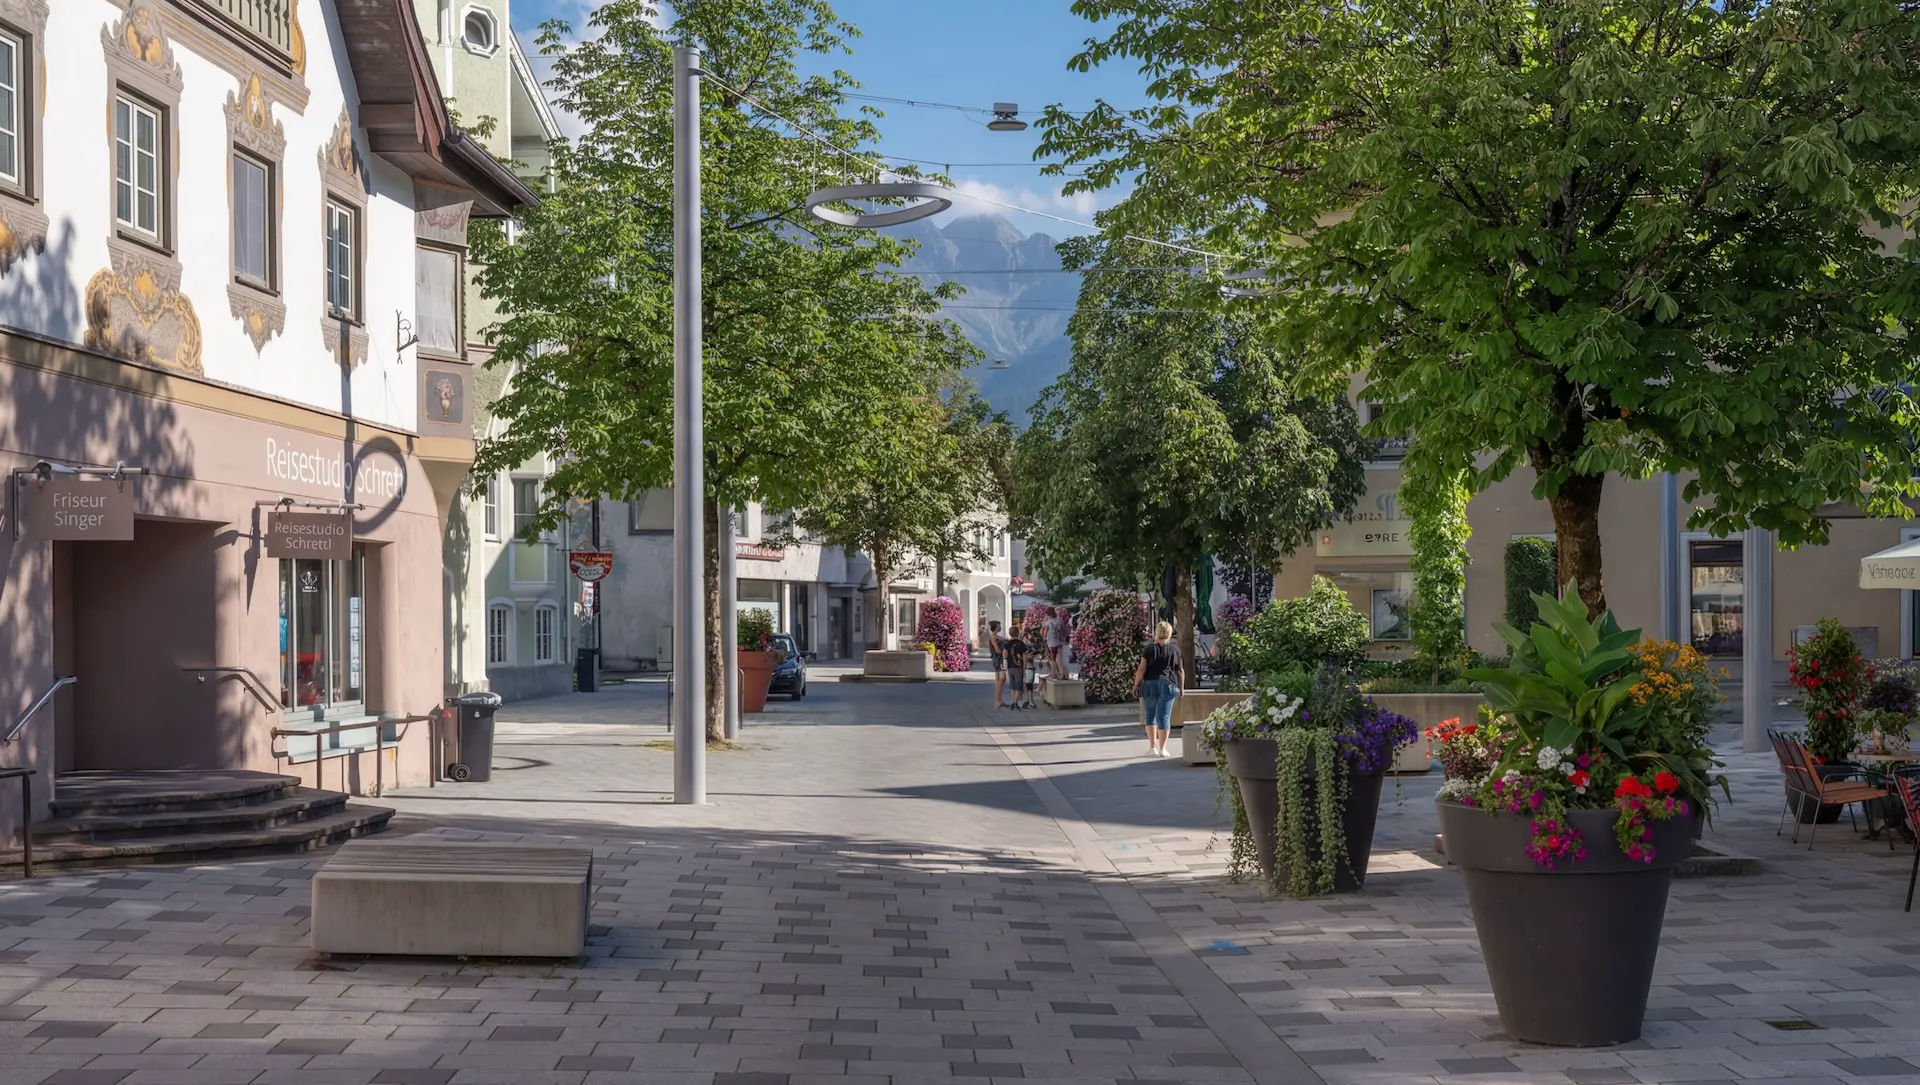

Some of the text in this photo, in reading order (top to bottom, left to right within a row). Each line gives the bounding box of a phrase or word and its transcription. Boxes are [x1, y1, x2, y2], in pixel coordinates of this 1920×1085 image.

[266, 437, 353, 491] Reisestudio
[53, 492, 107, 508] Friseur
[54, 511, 105, 531] Singer
[275, 521, 345, 536] Reisestudio
[285, 536, 332, 551] Schrettl
